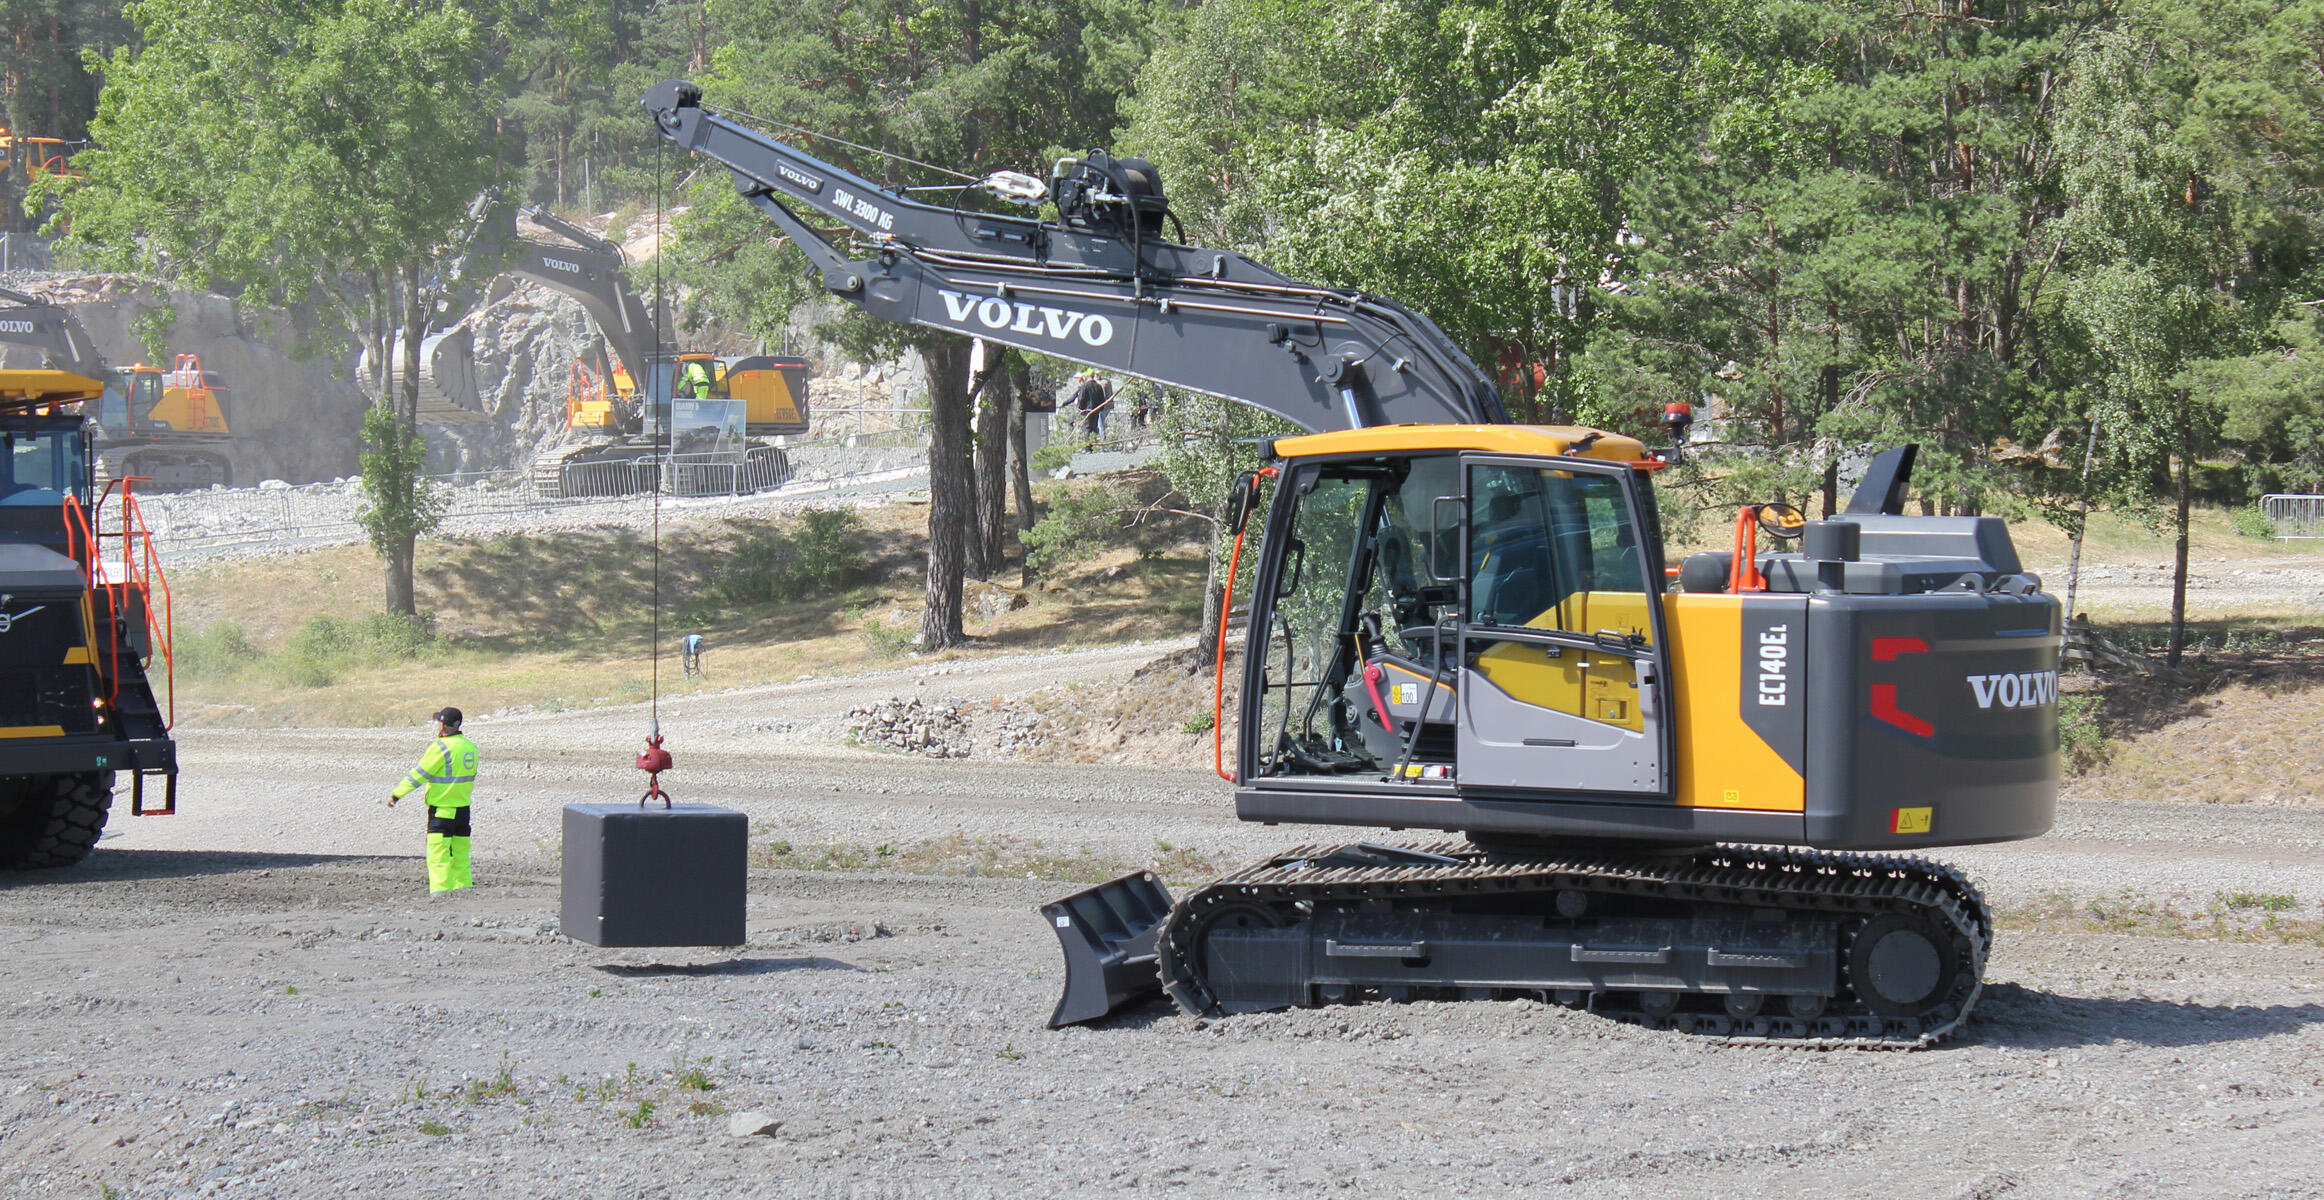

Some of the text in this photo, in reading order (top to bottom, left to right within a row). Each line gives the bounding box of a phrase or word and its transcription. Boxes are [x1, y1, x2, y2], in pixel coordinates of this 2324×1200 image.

[779, 165, 817, 189] VOLVO
[832, 188, 894, 230] SWL 3300 KG
[542, 257, 579, 273] VOLVO
[0, 320, 33, 333] OLVO
[938, 289, 1113, 346] VOLVO
[1759, 624, 1787, 706] EC140EL
[1967, 670, 2057, 708] VOLVO
